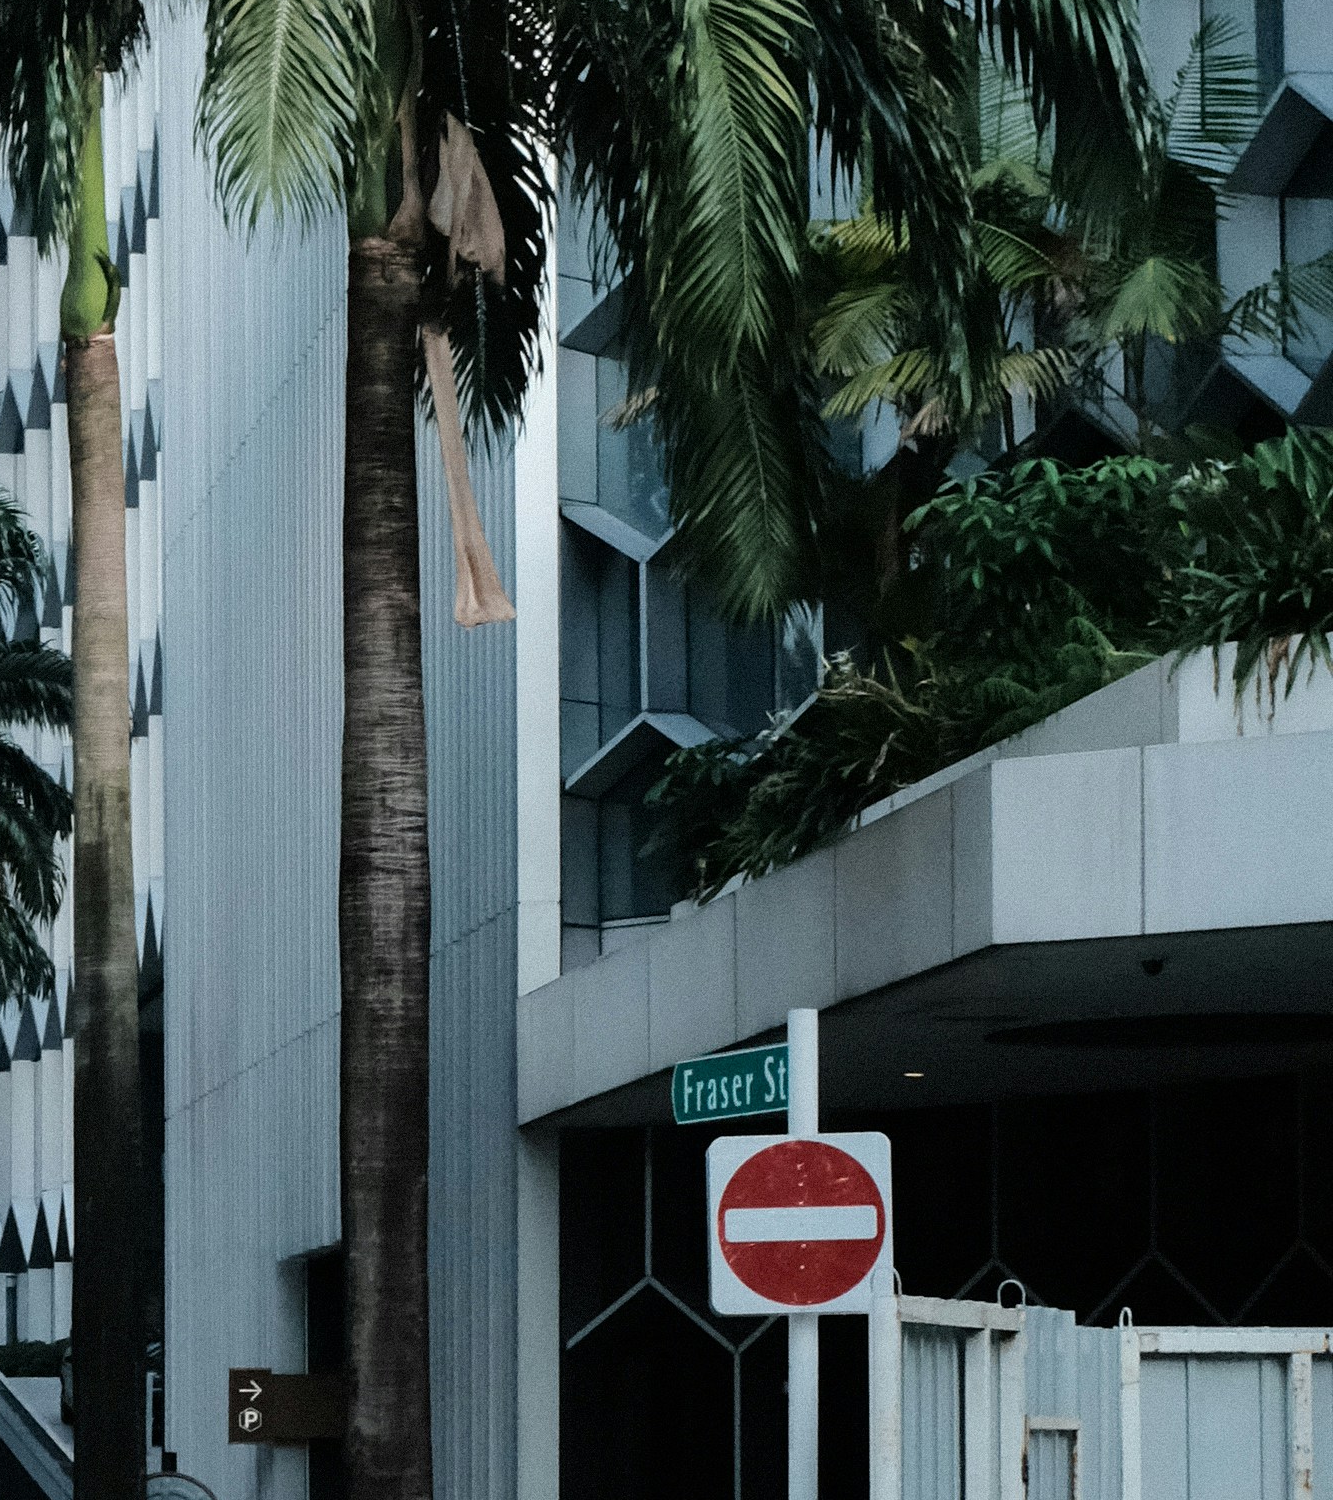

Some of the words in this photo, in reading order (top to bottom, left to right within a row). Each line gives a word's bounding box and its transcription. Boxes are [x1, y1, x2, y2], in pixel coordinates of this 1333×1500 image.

[683, 1068, 754, 1114] Fraser
[764, 1055, 787, 1103] St
[244, 1410, 259, 1429] P
